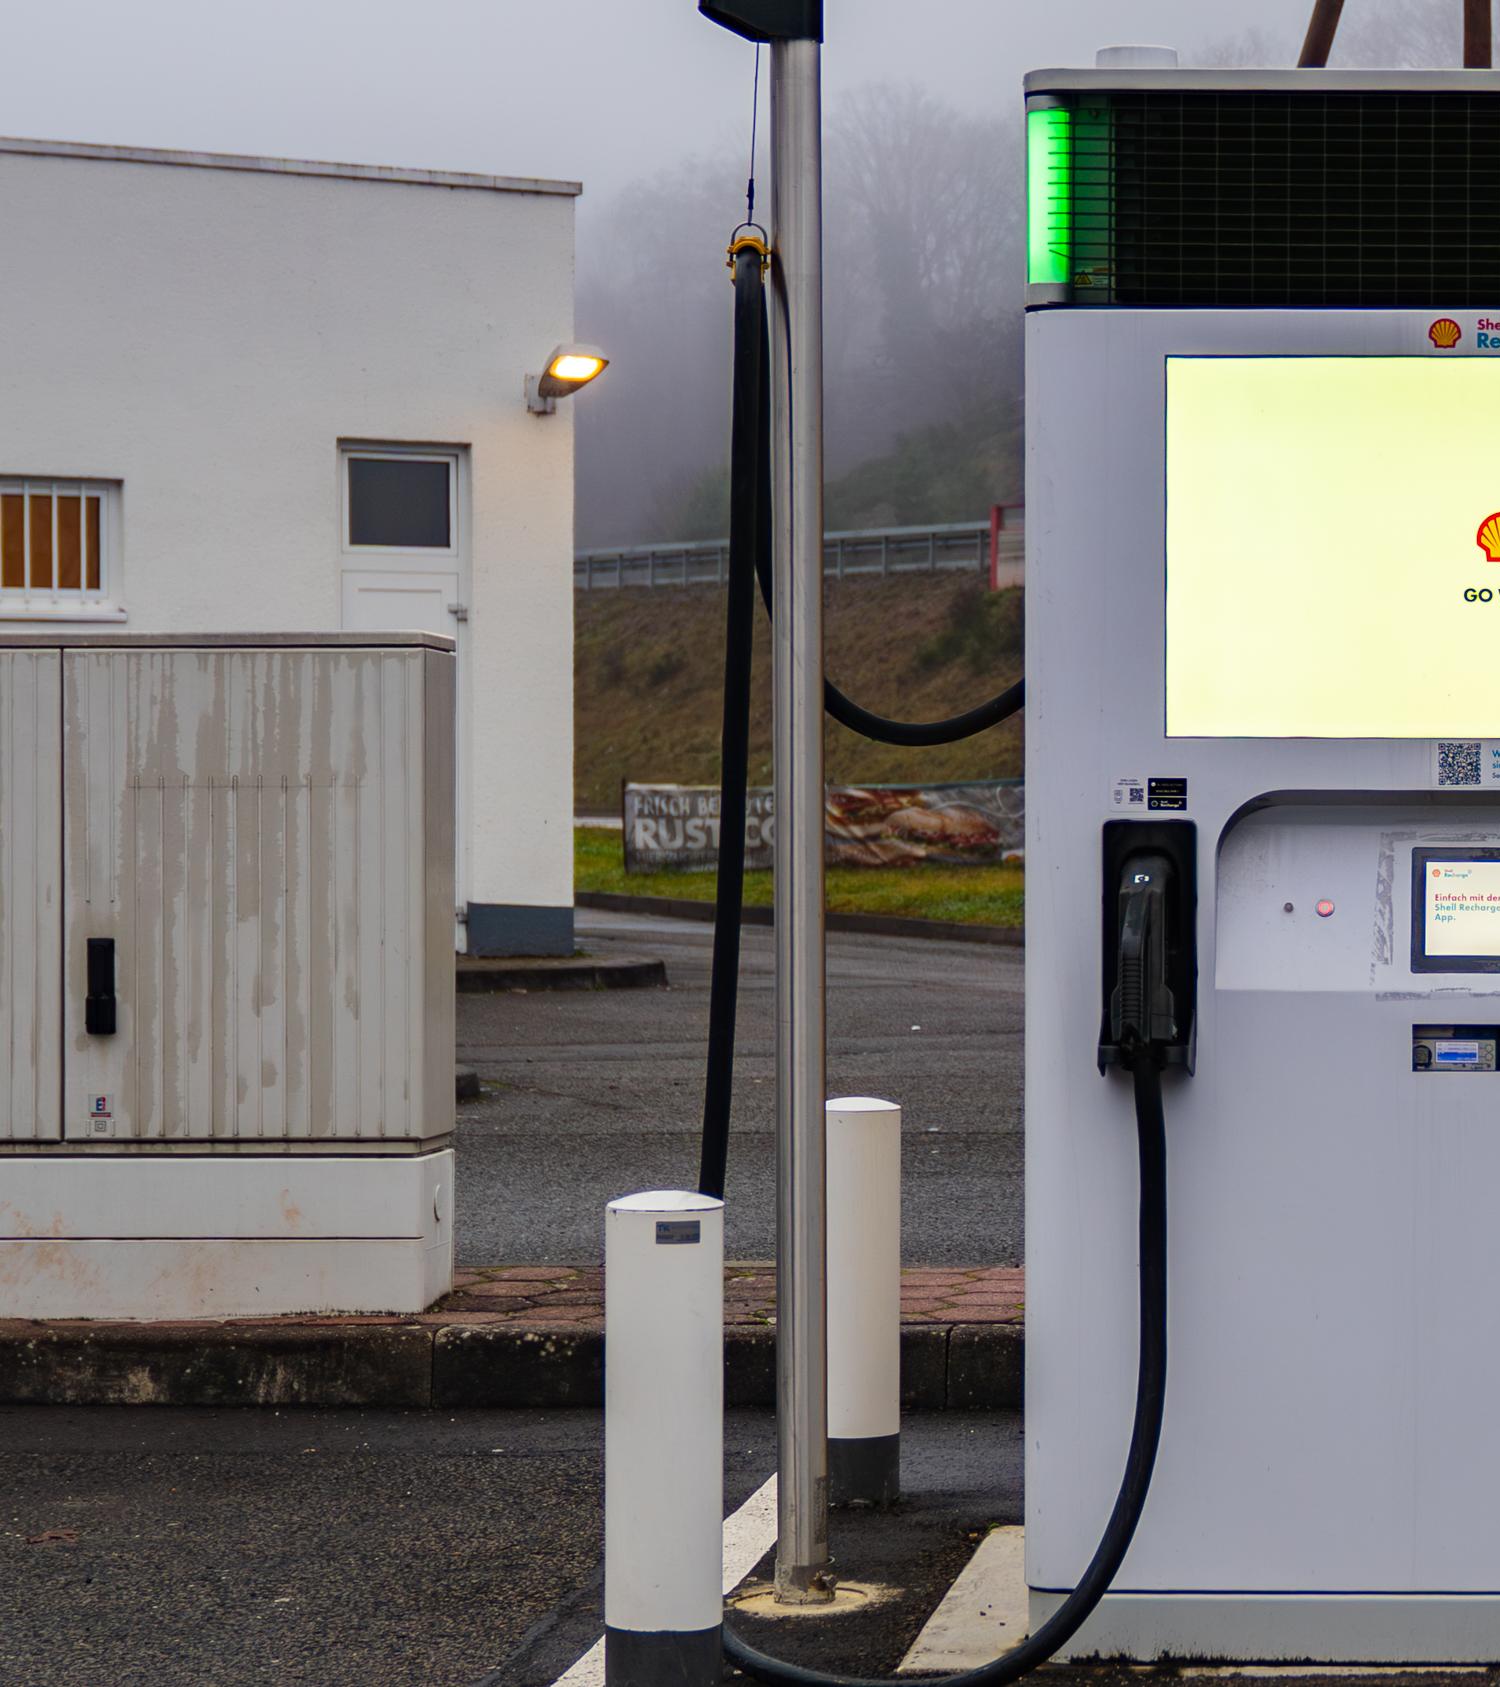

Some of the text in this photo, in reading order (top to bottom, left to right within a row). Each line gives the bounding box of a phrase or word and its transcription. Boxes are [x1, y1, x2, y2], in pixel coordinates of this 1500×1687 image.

[1463, 588, 1493, 602] GO
[634, 796, 690, 816] FRISCH
[1434, 893, 1467, 902] Einfach
[1469, 893, 1484, 902] mit
[1434, 903, 1457, 911] Shell
[1434, 913, 1456, 923] App.
